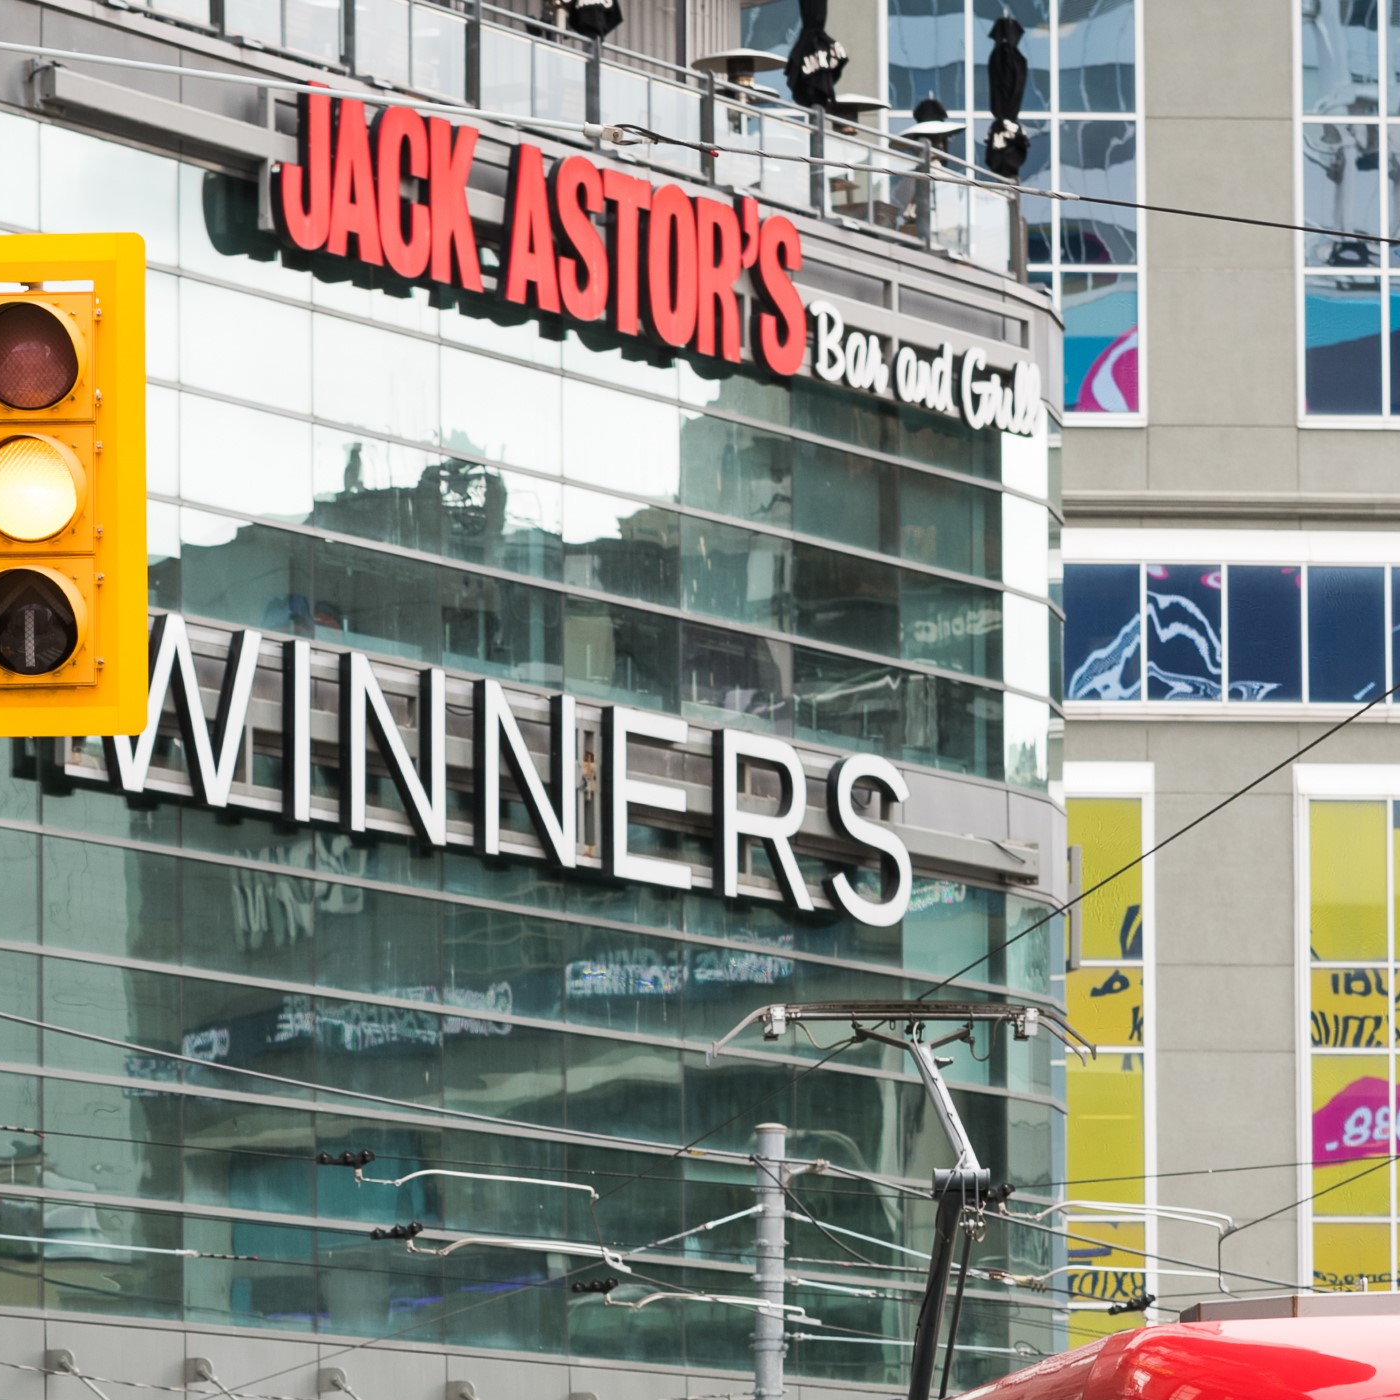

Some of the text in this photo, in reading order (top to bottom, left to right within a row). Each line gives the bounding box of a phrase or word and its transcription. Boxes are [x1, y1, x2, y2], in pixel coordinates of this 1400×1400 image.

[281, 81, 807, 377] JACK ASTOR'S
[809, 300, 1042, 436] Bar and Grill
[108, 613, 913, 928] WINNERS
